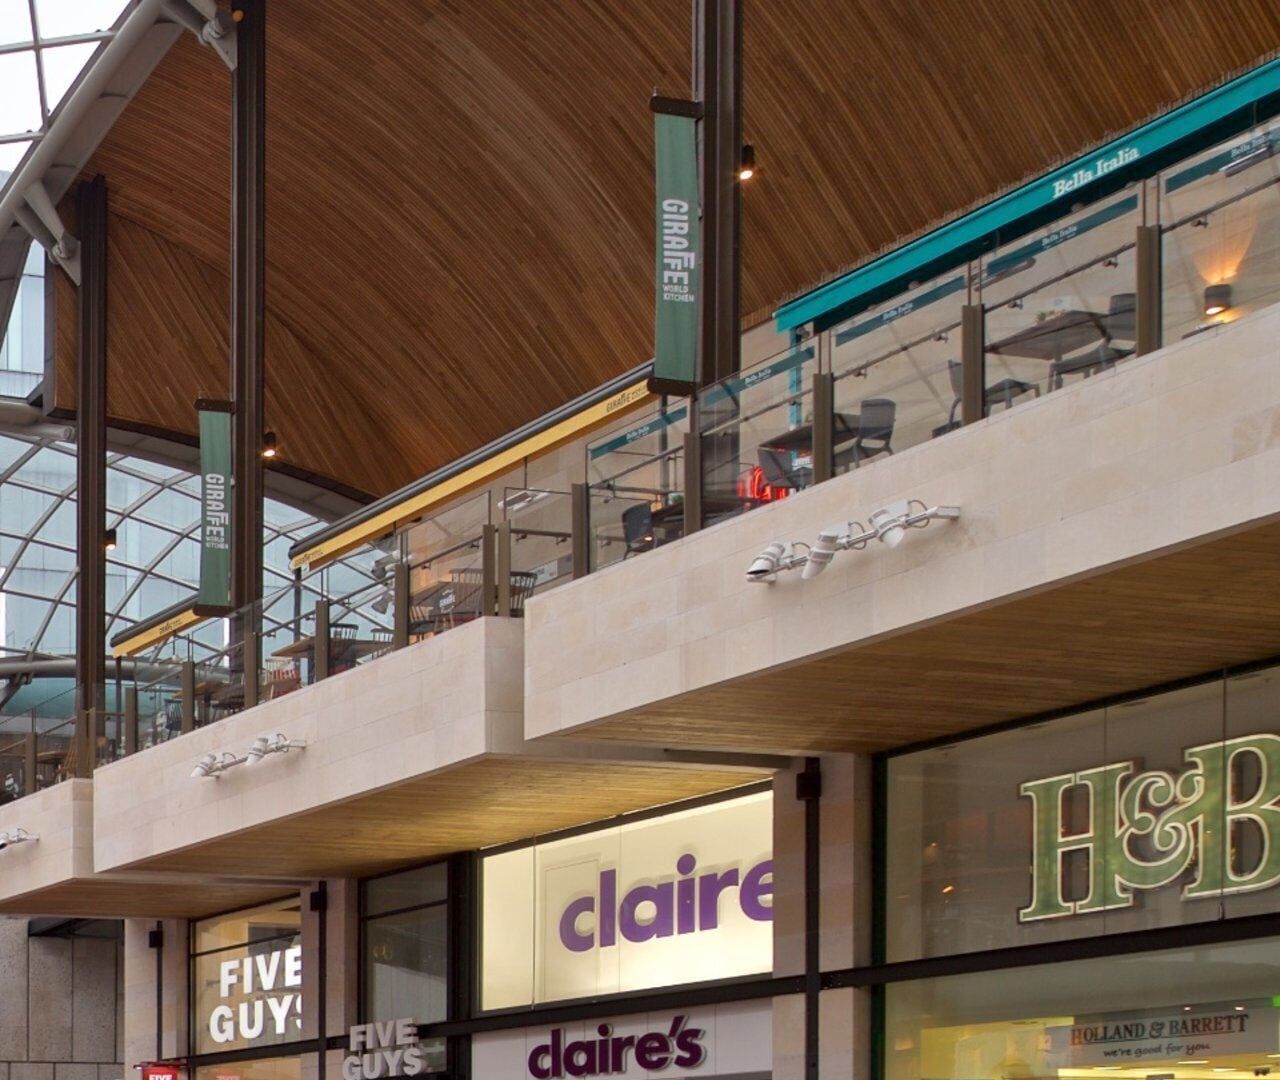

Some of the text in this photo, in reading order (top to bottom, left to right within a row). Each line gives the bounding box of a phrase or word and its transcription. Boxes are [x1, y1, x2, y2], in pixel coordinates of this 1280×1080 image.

[1053, 147, 1139, 199] Bella Italia
[662, 199, 695, 284] GIRAFFE
[663, 284, 688, 293] WORLD
[663, 292, 695, 302] KITCHEN
[205, 473, 228, 536] GIRAFFE
[1020, 733, 1280, 922] H&B
[220, 945, 302, 998] FIVE
[209, 995, 302, 1043] GUY
[349, 1017, 419, 1052] FIVE
[1071, 1014, 1249, 1046] HOLLAND & BARRETT
[528, 1014, 706, 1080] claire's
[1103, 1043, 1211, 1057] we're good for you
